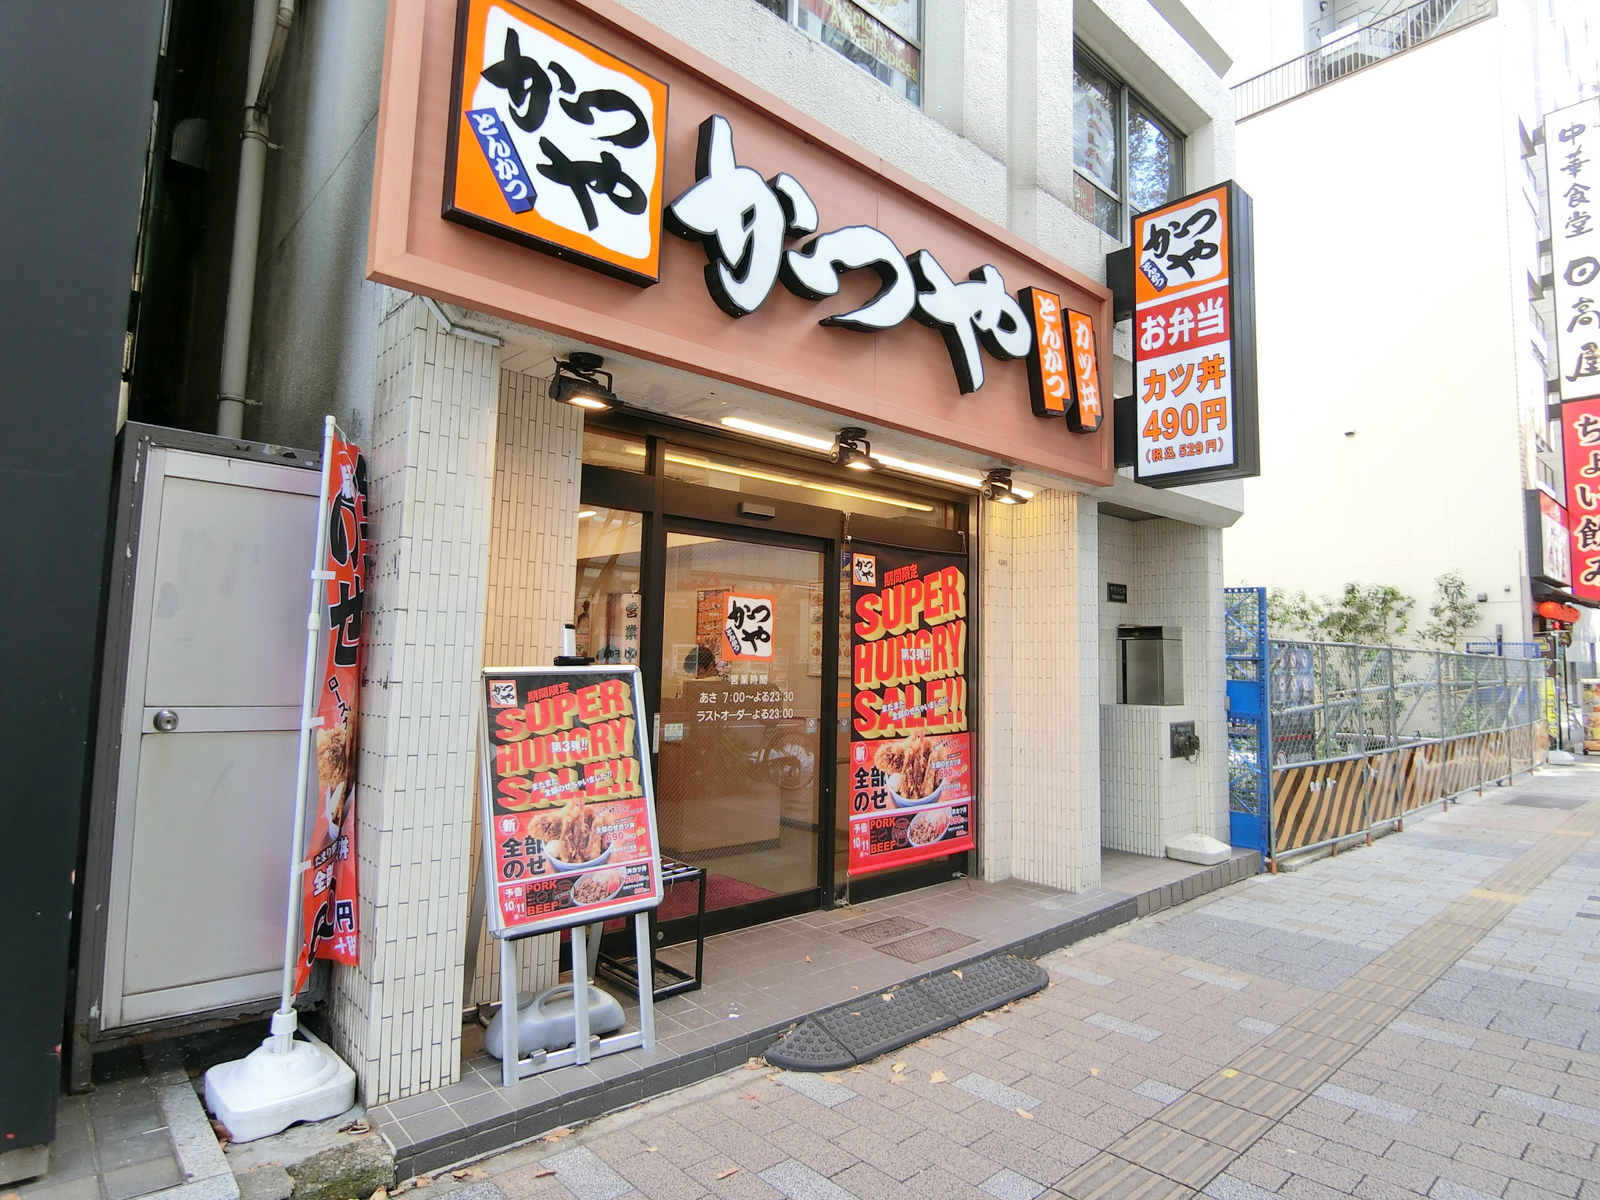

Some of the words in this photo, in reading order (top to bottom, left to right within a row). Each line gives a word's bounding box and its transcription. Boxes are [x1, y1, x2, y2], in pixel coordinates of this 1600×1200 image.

[480, 27, 650, 231] かつや
[472, 113, 528, 200] とんかつ
[1558, 122, 1593, 238] 中華食堂
[668, 114, 1033, 394] かつや
[1142, 208, 1219, 279] かつや
[1140, 296, 1225, 351] お弁当
[1038, 295, 1066, 398] とんかつ
[1075, 320, 1099, 412] カツ丼
[1141, 353, 1227, 404] カツ丼
[1142, 396, 1228, 443] 490円
[855, 558, 874, 582] かつや
[884, 563, 919, 587] 期間限定
[855, 566, 963, 638] SUPER
[624, 602, 639, 663] 営業中
[727, 600, 771, 652] かつや
[855, 620, 965, 688] HUNGRY
[730, 674, 768, 685] 営業時間
[493, 683, 515, 704] かつや
[527, 682, 569, 703] 期間限定
[699, 692, 718, 704] あさ
[496, 679, 630, 740] SUPER
[697, 708, 794, 722] ラストオーダーよる23:00
[854, 676, 965, 735] SALE!!
[881, 700, 905, 713] またまた
[496, 717, 632, 776] HUNGRY
[855, 746, 866, 761] 新
[497, 757, 638, 808] SALE!!
[531, 778, 559, 791] またまた
[854, 766, 886, 790] 全部
[854, 790, 888, 812] のせ
[502, 818, 516, 833] 新
[870, 817, 896, 830] PORK
[501, 834, 544, 859] 全部
[870, 841, 896, 854] BEEF
[502, 856, 547, 879] のせ
[504, 887, 524, 897] 予告
[526, 880, 558, 893] PORK
[527, 901, 559, 916] BEEF
